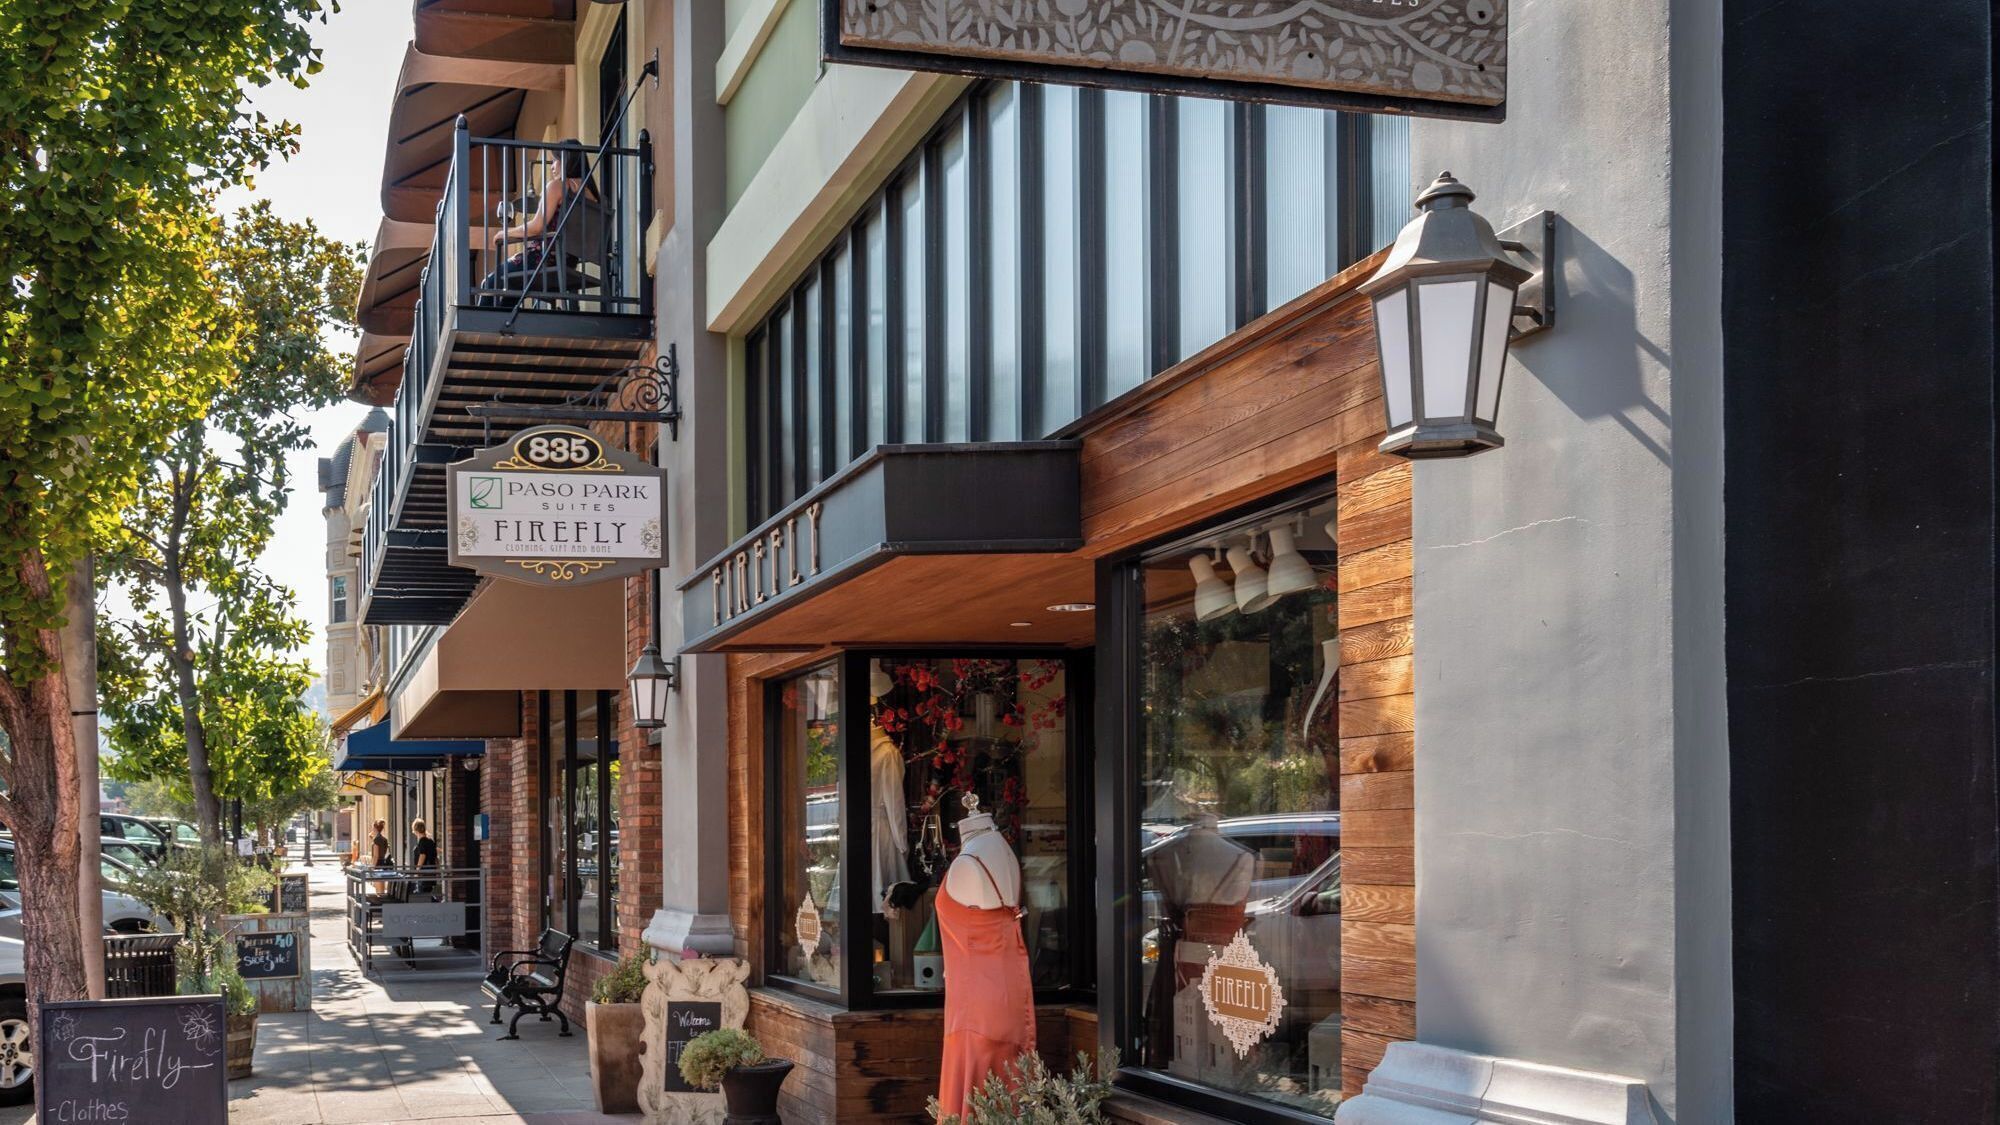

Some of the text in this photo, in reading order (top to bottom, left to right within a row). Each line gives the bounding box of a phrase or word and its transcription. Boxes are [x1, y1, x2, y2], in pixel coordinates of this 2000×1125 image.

[528, 437, 590, 463] 835
[508, 482, 649, 500] PASO PARK
[542, 502, 615, 512] SUITES
[494, 520, 627, 543] FIREFLY
[550, 544, 568, 552] GIFT
[571, 545, 587, 553] AND
[591, 545, 611, 553] HOME
[712, 502, 823, 627] FIREFLY
[1214, 976, 1268, 1011] FIREFLY
[672, 1010, 712, 1028] Welcome
[68, 1028, 213, 1089] Firefly
